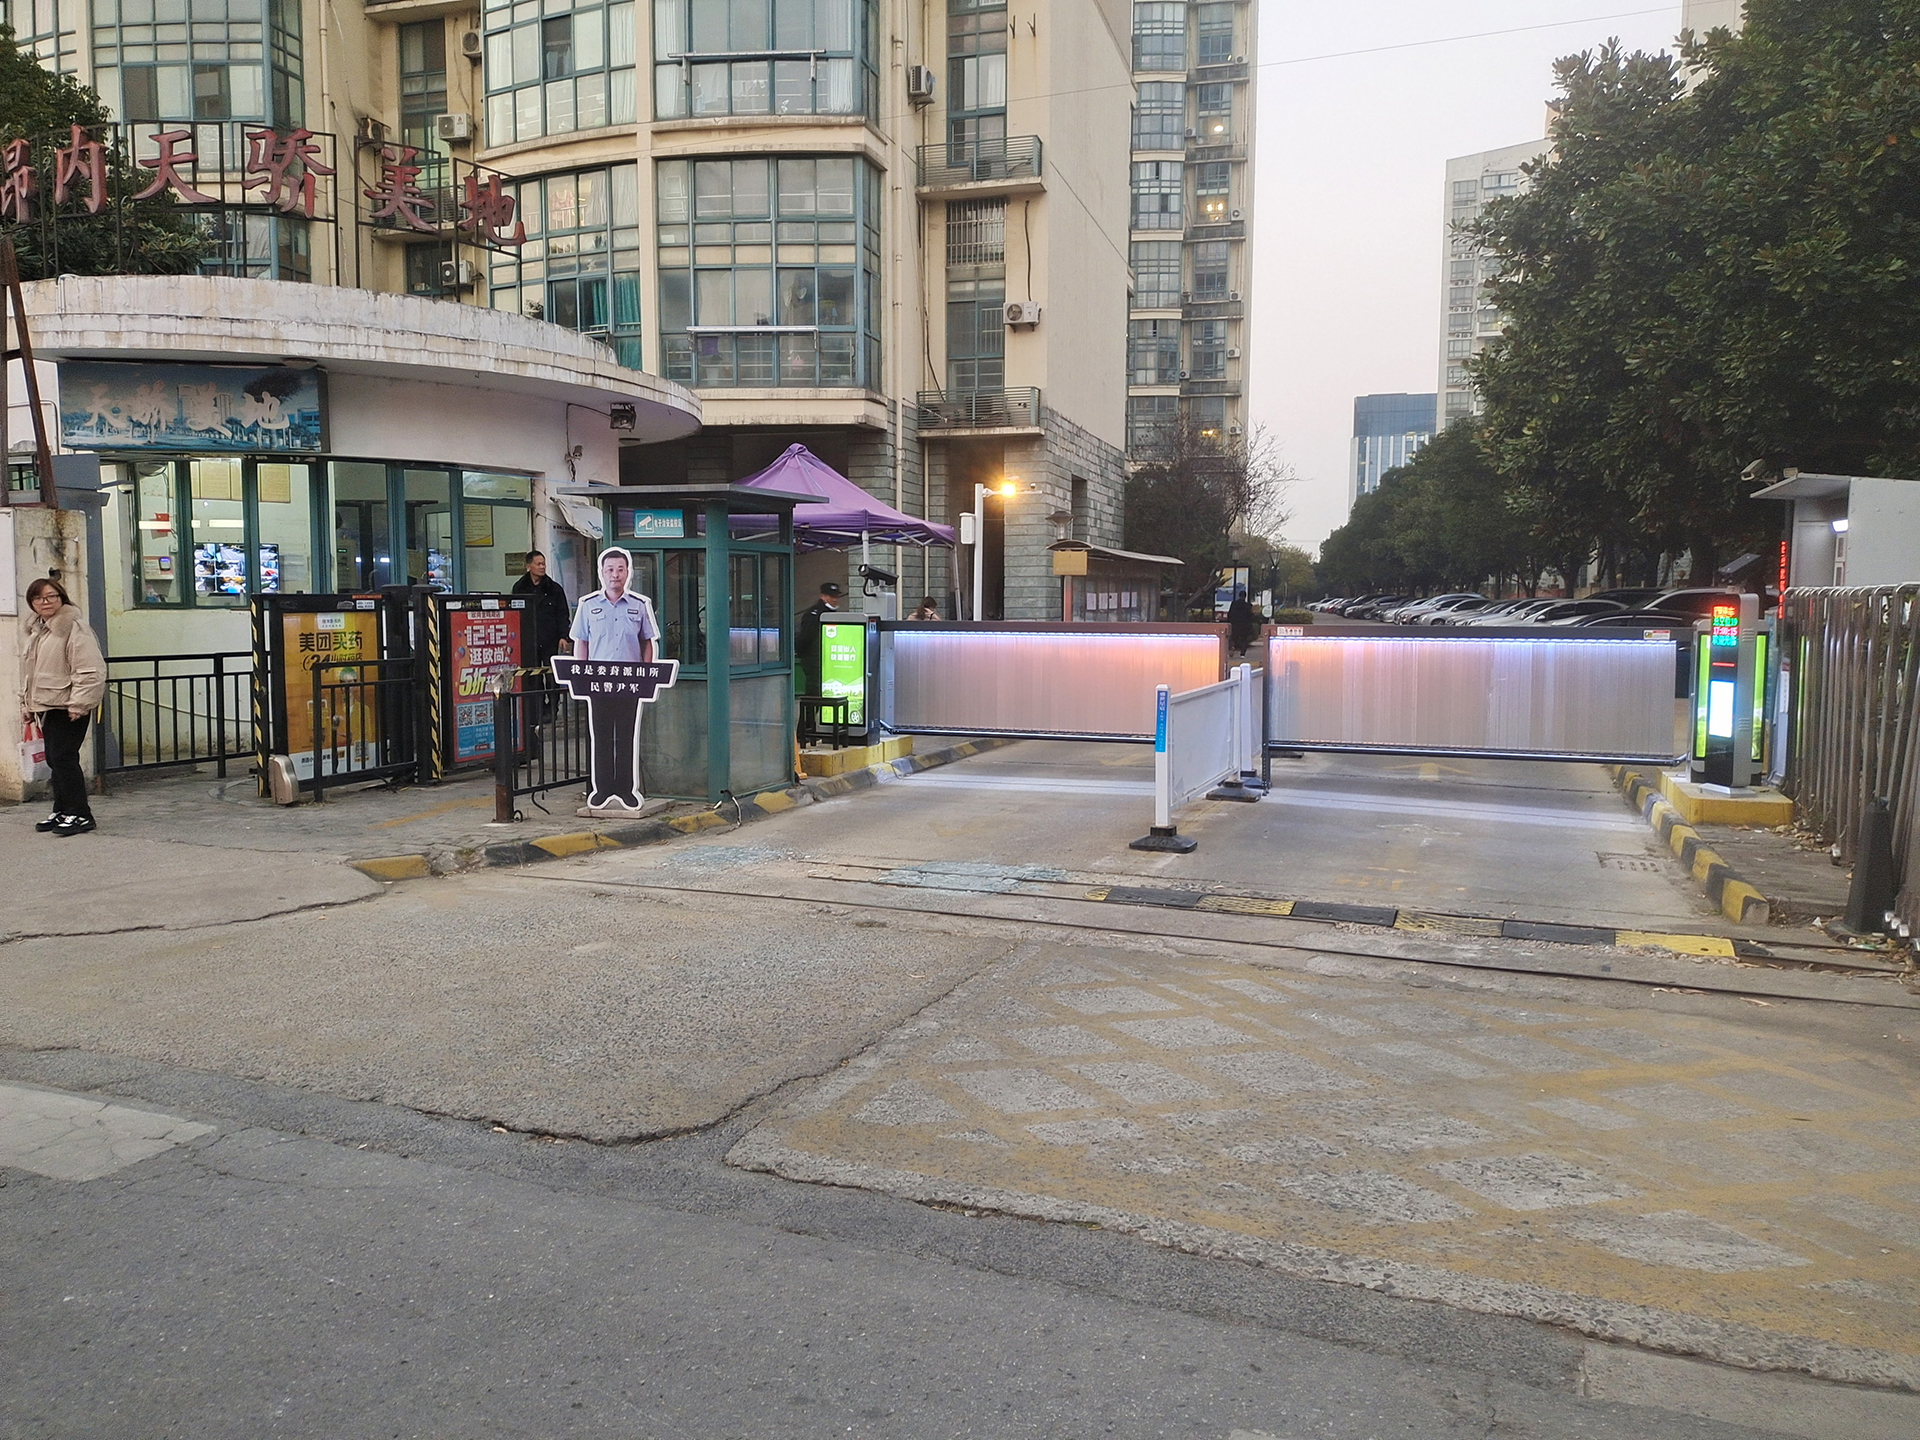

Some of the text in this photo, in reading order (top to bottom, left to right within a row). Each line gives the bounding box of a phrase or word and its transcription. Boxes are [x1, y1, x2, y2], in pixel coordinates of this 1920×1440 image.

[299, 630, 363, 653] 美团买药
[464, 624, 508, 646] 12.12
[470, 647, 505, 666] 逛欧尚
[570, 664, 660, 678] 我是娄葑派出所
[590, 681, 640, 694] 民警尹军
